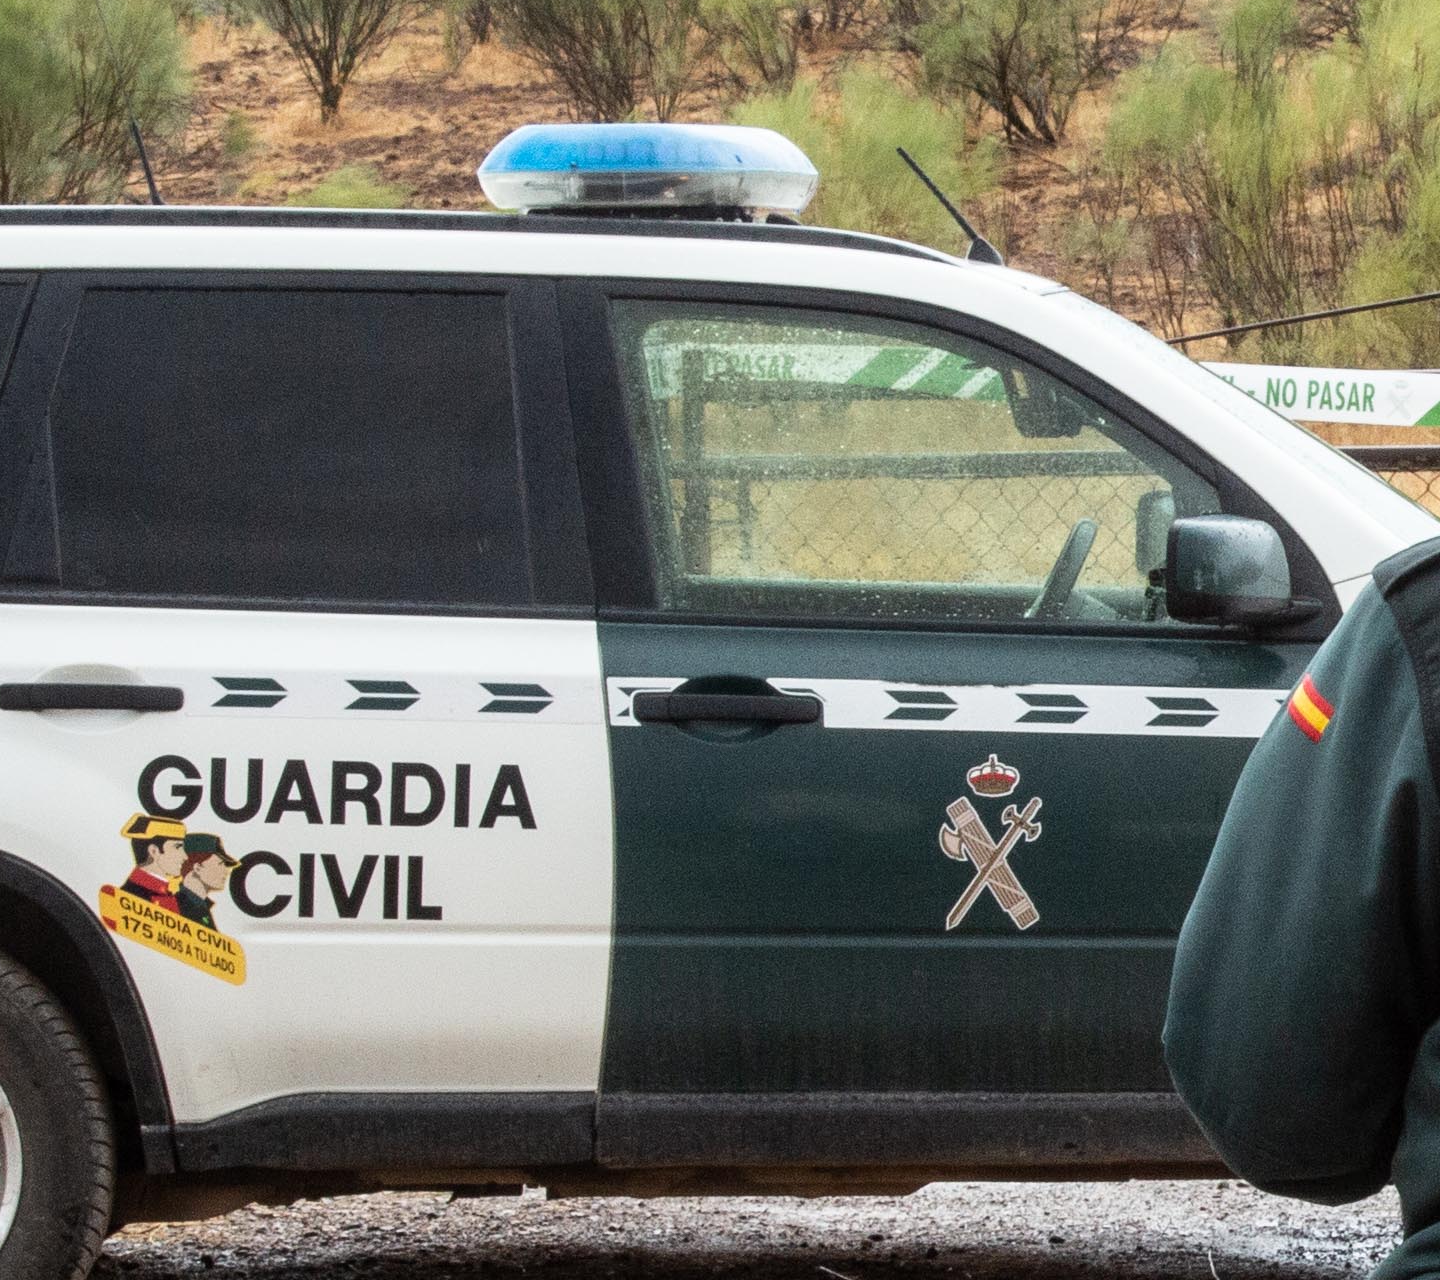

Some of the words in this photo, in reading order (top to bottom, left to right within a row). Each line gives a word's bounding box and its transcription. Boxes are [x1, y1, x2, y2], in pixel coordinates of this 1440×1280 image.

[1265, 377, 1298, 408] NO
[1307, 379, 1375, 413] PASAR
[137, 754, 538, 830] GUARDIA
[229, 850, 443, 921] CIVIL
[119, 896, 192, 937] GUARDIA
[196, 928, 237, 956] CIVIL
[122, 915, 154, 939] 175
[157, 930, 184, 954] AÑOS
[185, 944, 193, 957] A
[195, 947, 208, 963] TU
[211, 955, 236, 975] LADO
